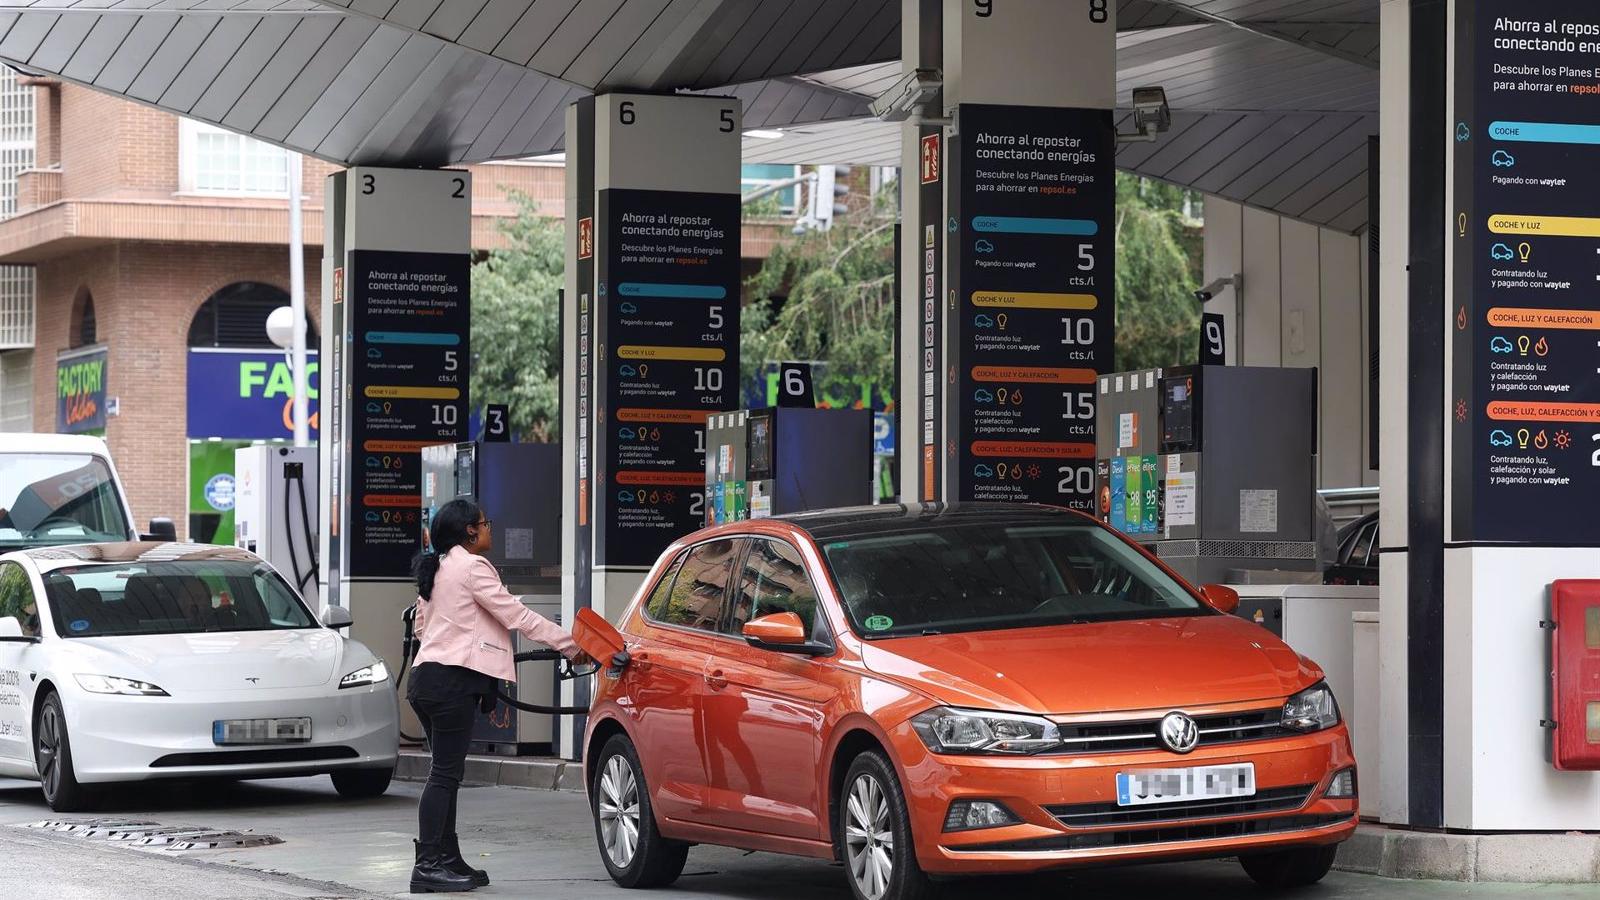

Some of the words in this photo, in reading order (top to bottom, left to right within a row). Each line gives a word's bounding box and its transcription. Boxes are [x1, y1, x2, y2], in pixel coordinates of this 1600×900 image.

[974, 0, 992, 18] 9
[1088, 0, 1108, 23] 8
[1494, 18, 1540, 32] Ahorra
[1544, 19, 1556, 33] al
[1562, 24, 1600, 38] repos
[1494, 37, 1575, 52] conectando
[1494, 64, 1540, 75] Descubre
[1542, 65, 1557, 76] los
[1559, 67, 1592, 78] Planes
[1493, 82, 1516, 92] para
[1518, 81, 1553, 92] ahorrar
[1556, 84, 1568, 93] en
[620, 101, 636, 125] 6
[719, 109, 735, 132] 5
[1494, 128, 1520, 136] COCHE
[976, 133, 1015, 145] Ahorra
[1018, 134, 1029, 146] al
[1032, 137, 1080, 148] repostar
[976, 148, 1044, 160] conectando
[1048, 152, 1096, 165] energías
[362, 174, 375, 194] 3
[976, 170, 1015, 179] Descubre
[1016, 171, 1029, 180] los
[1031, 172, 1058, 181] Planes
[1060, 173, 1094, 184] Energías
[1492, 176, 1524, 185] Pagando
[1540, 178, 1566, 187] waylet
[452, 178, 465, 198] 2
[976, 184, 995, 193] para
[996, 184, 1026, 192] ahorrar
[1040, 186, 1076, 195] repsol.es
[622, 213, 655, 223] Ahorra
[658, 214, 667, 224] al
[670, 216, 711, 227] repostar
[1494, 220, 1519, 229] COCHE
[622, 226, 680, 236] conectando
[682, 229, 724, 240] energías
[622, 244, 655, 252] Descubre
[668, 245, 692, 254] Planes
[693, 246, 723, 256] Energías
[1077, 244, 1095, 270] 5
[975, 260, 1002, 268] Pagando
[368, 271, 398, 280] Ahorra
[400, 272, 408, 280] al
[410, 273, 446, 283] repostar
[1492, 269, 1536, 278] Contratando
[1536, 270, 1548, 278] luz
[368, 282, 420, 291] conectando
[421, 284, 458, 294] energías
[1069, 276, 1094, 286] cts./l
[1497, 280, 1528, 289] pagando
[1544, 282, 1570, 290] waylet
[709, 306, 723, 328] 5
[1493, 314, 1520, 322] COCHE,
[1543, 316, 1593, 324] CALEFACCIÓN
[1061, 318, 1094, 345] 10
[1206, 321, 1223, 355] 9
[444, 351, 458, 371] 5
[1069, 351, 1094, 360] cts./l
[1491, 362, 1535, 371] Contratando
[58, 360, 104, 398] FACTORY
[694, 368, 723, 391] 10
[784, 368, 805, 396] 6
[1496, 372, 1538, 381] calefacción
[1496, 383, 1528, 392] pagando
[1544, 384, 1570, 393] waylet
[700, 396, 722, 404] cts./l
[1062, 392, 1094, 419] 15
[432, 405, 457, 425] 10
[1492, 407, 1519, 416] COCHE,
[1520, 408, 1536, 416] LUZ,
[1538, 408, 1588, 417] CALEFACCIÓN
[489, 410, 504, 434] 3
[1069, 425, 1094, 434] cts./l
[1490, 455, 1534, 464] Contratando
[1536, 456, 1548, 465] luz,
[1490, 465, 1531, 474] calefacción
[1058, 466, 1094, 494] 20
[1496, 476, 1528, 485] pagando
[1543, 477, 1570, 486] waylet
[1069, 500, 1094, 509] cts./l
[1130, 491, 1140, 506] 98
[1146, 490, 1156, 505] 95
